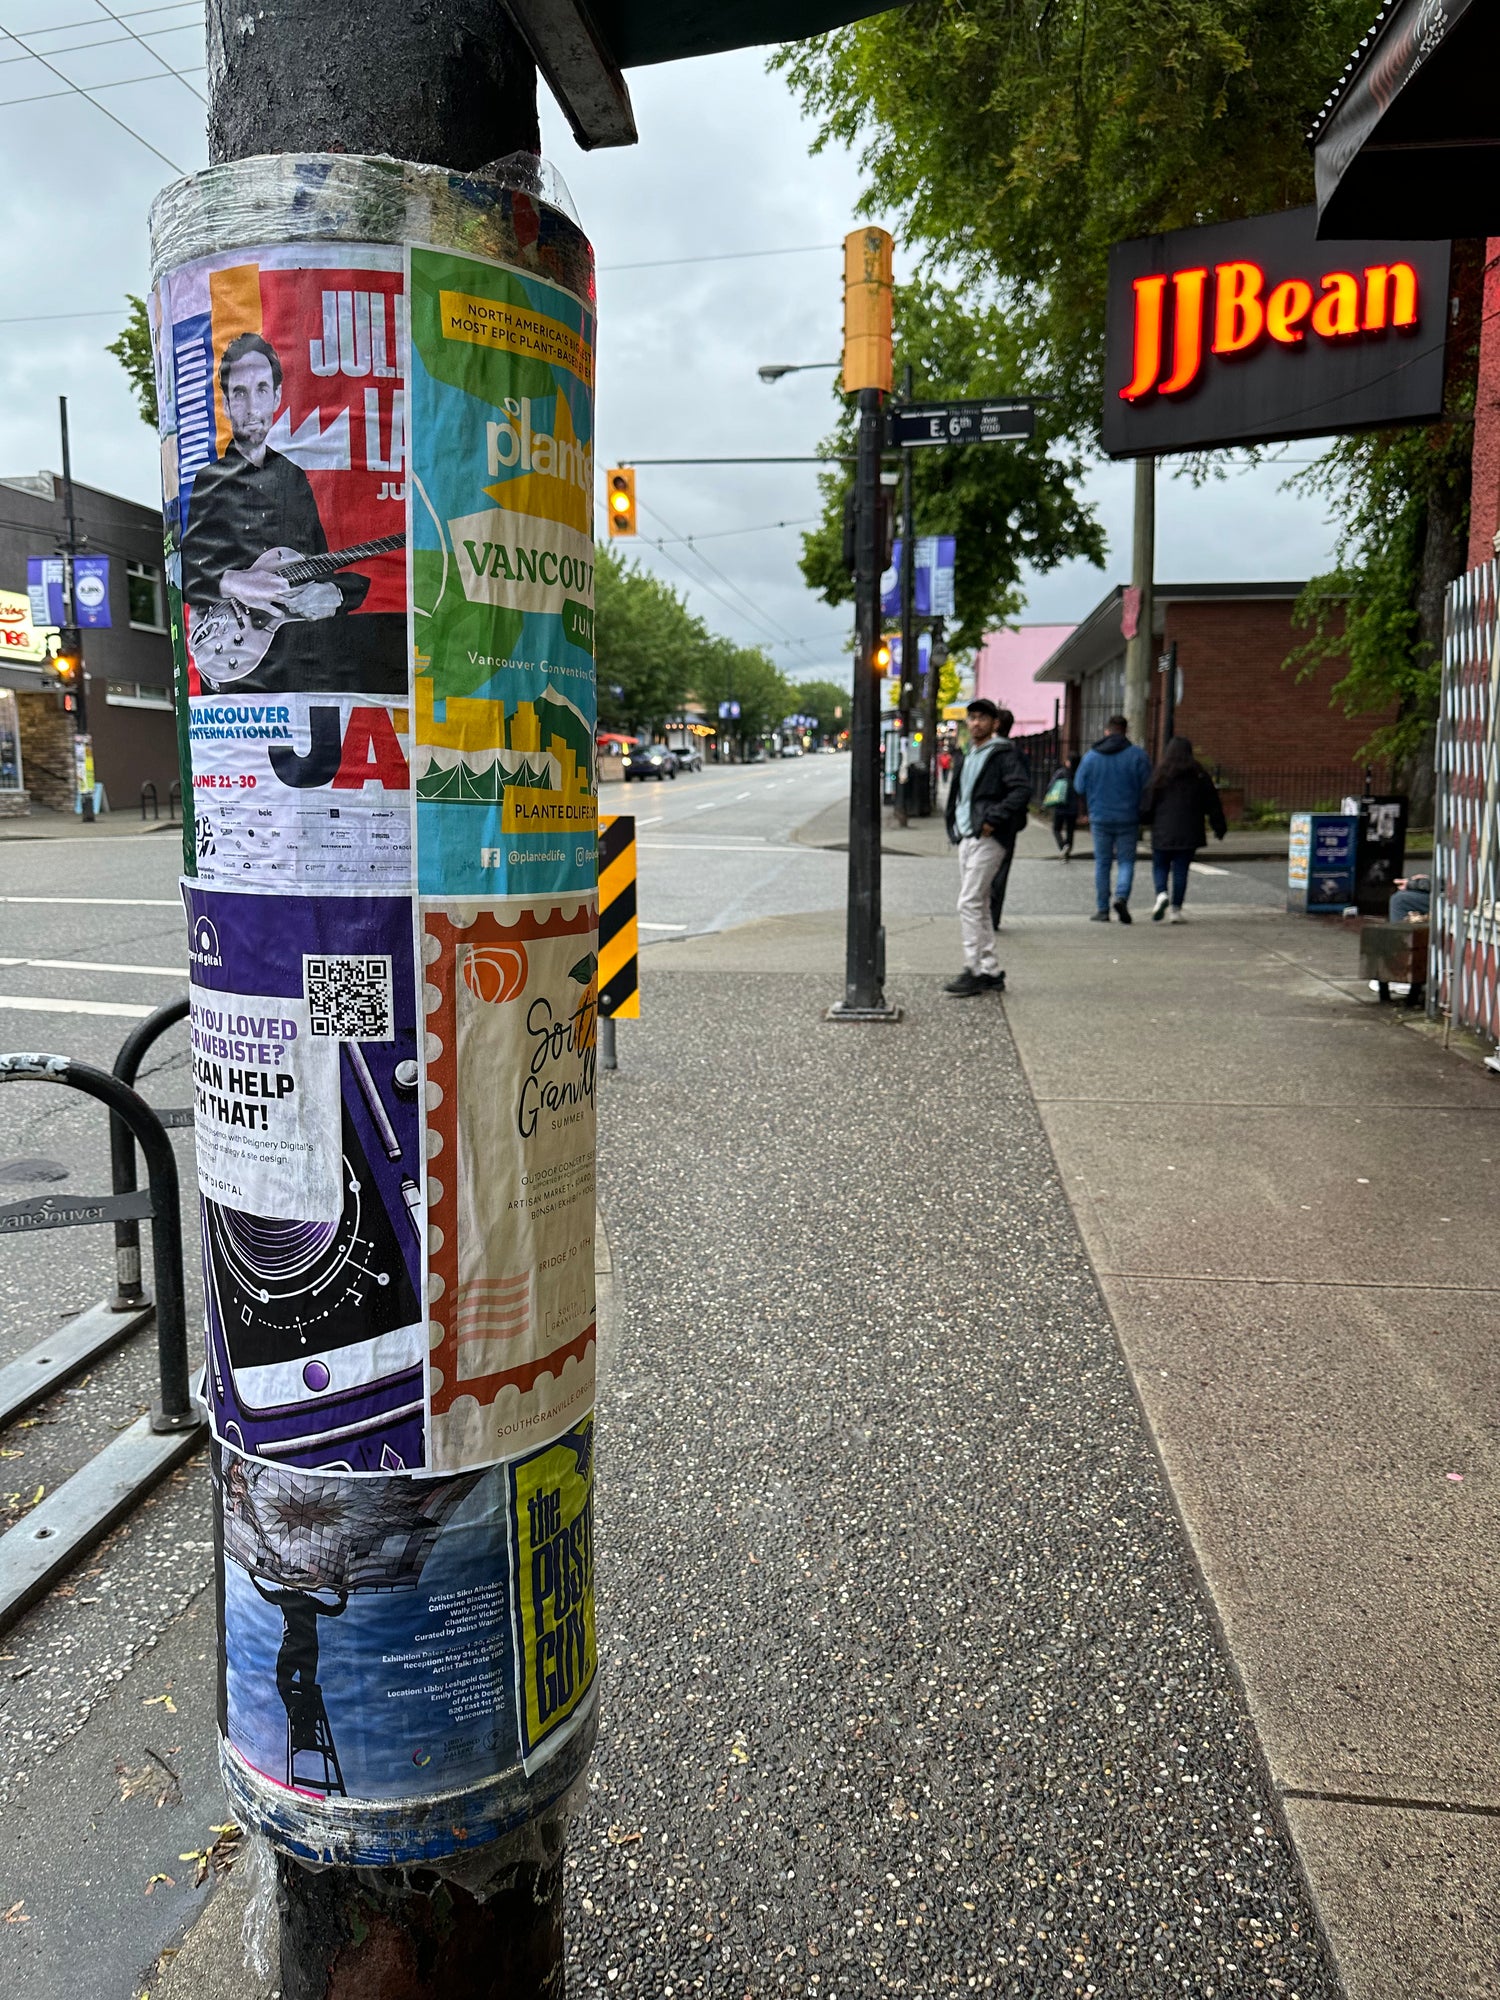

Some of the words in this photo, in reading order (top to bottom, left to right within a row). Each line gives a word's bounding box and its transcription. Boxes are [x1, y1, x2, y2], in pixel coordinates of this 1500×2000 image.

[468, 303, 512, 324] NORTH
[515, 318, 569, 345] AMERICA'S
[451, 317, 488, 335] MOST
[491, 327, 517, 344] EPIC
[520, 335, 578, 368] PLANT-BASED
[929, 418, 945, 437] E.
[949, 416, 972, 436] 6th
[467, 651, 535, 671] Vancouver
[190, 706, 290, 725] VANCOUVER
[189, 725, 293, 740] INTERNATIONAL
[268, 706, 411, 790] JA
[192, 775, 216, 788] JUNE
[508, 849, 566, 866] @plantedlife
[200, 1006, 223, 1033] YOU
[227, 1013, 298, 1041] LOVED
[201, 1031, 285, 1066] WEBISTE?
[198, 1056, 223, 1090] CAN
[228, 1067, 295, 1099] HELP
[208, 1093, 268, 1131] THAT!
[551, 1111, 584, 1130] SUMMER
[280, 1141, 314, 1152] Digital's
[259, 1154, 290, 1165] design.
[521, 1166, 557, 1185] OUTDOOR
[558, 1154, 586, 1173] CONCERT
[210, 1178, 243, 1196] DIGITAL
[508, 1194, 542, 1210] ARTISAN
[544, 1183, 570, 1200] MARKET
[531, 1203, 557, 1220] BONSAI
[539, 1251, 567, 1273] BRIDGE
[569, 1246, 577, 1258] TO
[527, 1487, 561, 1549] the
[428, 1593, 456, 1604] Artists:
[428, 1600, 466, 1613] Catherine
[450, 1606, 470, 1617] Wally
[491, 1597, 504, 1607] and
[444, 1614, 478, 1627] Charlene
[414, 1630, 445, 1642] Curated
[446, 1628, 456, 1637] by
[456, 1623, 478, 1634] Daina
[382, 1654, 421, 1663] Exhibition
[403, 1658, 444, 1670] Reception:
[445, 1654, 461, 1663] May
[432, 1664, 453, 1674] Artist
[473, 1656, 490, 1665] Date
[491, 1649, 504, 1659] TBD
[387, 1689, 423, 1698] Location:
[423, 1684, 444, 1694] Libby
[445, 1675, 478, 1689] Leshgold
[430, 1691, 452, 1701] Emily
[452, 1687, 469, 1696] Carr
[469, 1676, 503, 1692] University
[452, 1698, 460, 1706] of
[461, 1695, 473, 1704] Art
[481, 1685, 504, 1698] Design
[464, 1702, 480, 1711] East
[492, 1694, 505, 1704] Ave
[495, 1703, 505, 1711] BC
